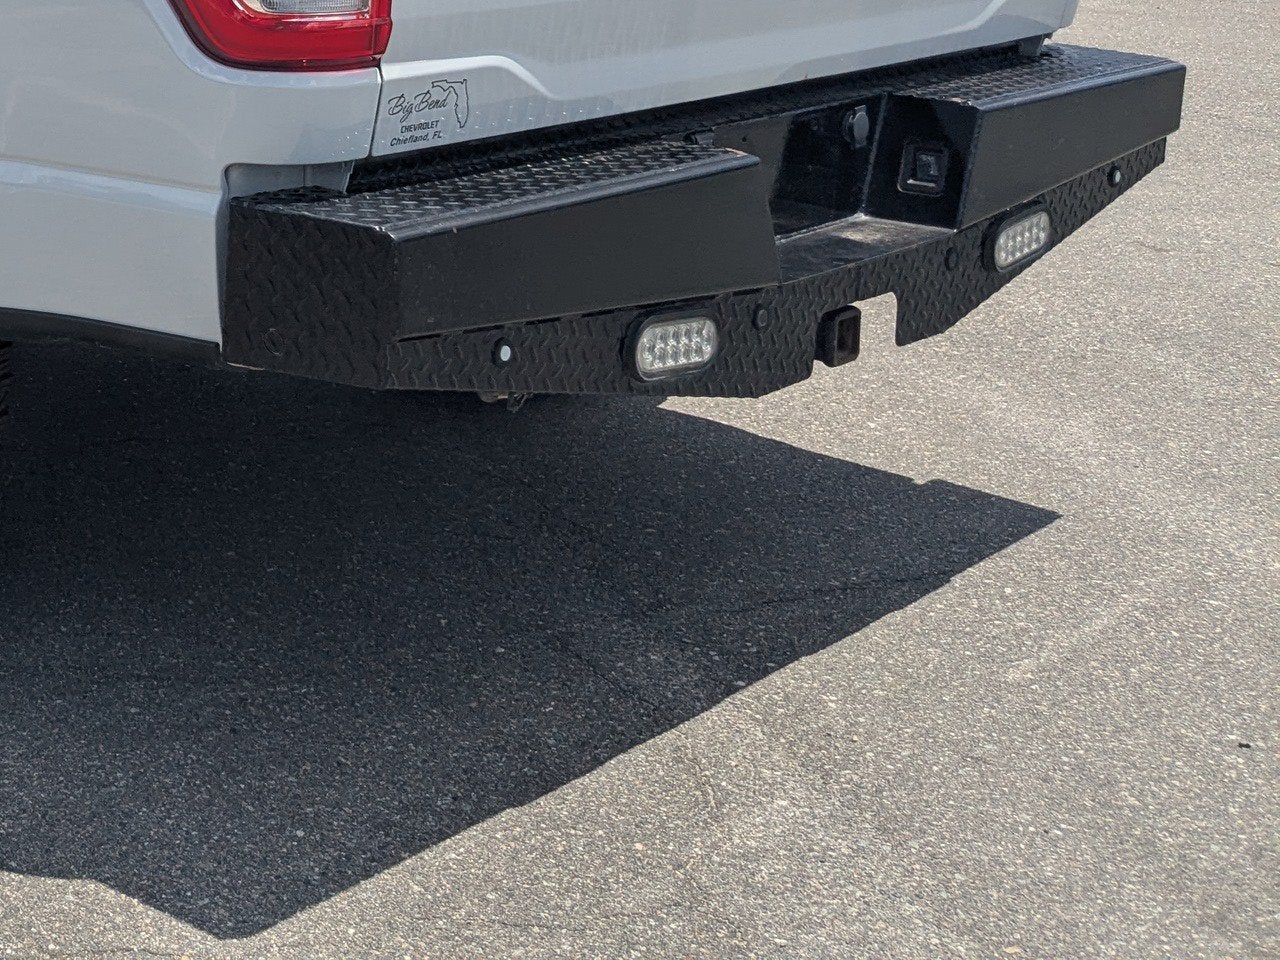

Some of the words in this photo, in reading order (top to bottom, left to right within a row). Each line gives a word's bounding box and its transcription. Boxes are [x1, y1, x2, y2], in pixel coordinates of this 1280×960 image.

[387, 93, 415, 123] Big
[414, 89, 451, 113] Bend
[400, 120, 440, 134] CHEVROLET
[389, 134, 430, 147] Chiefland,
[432, 130, 442, 140] FL
